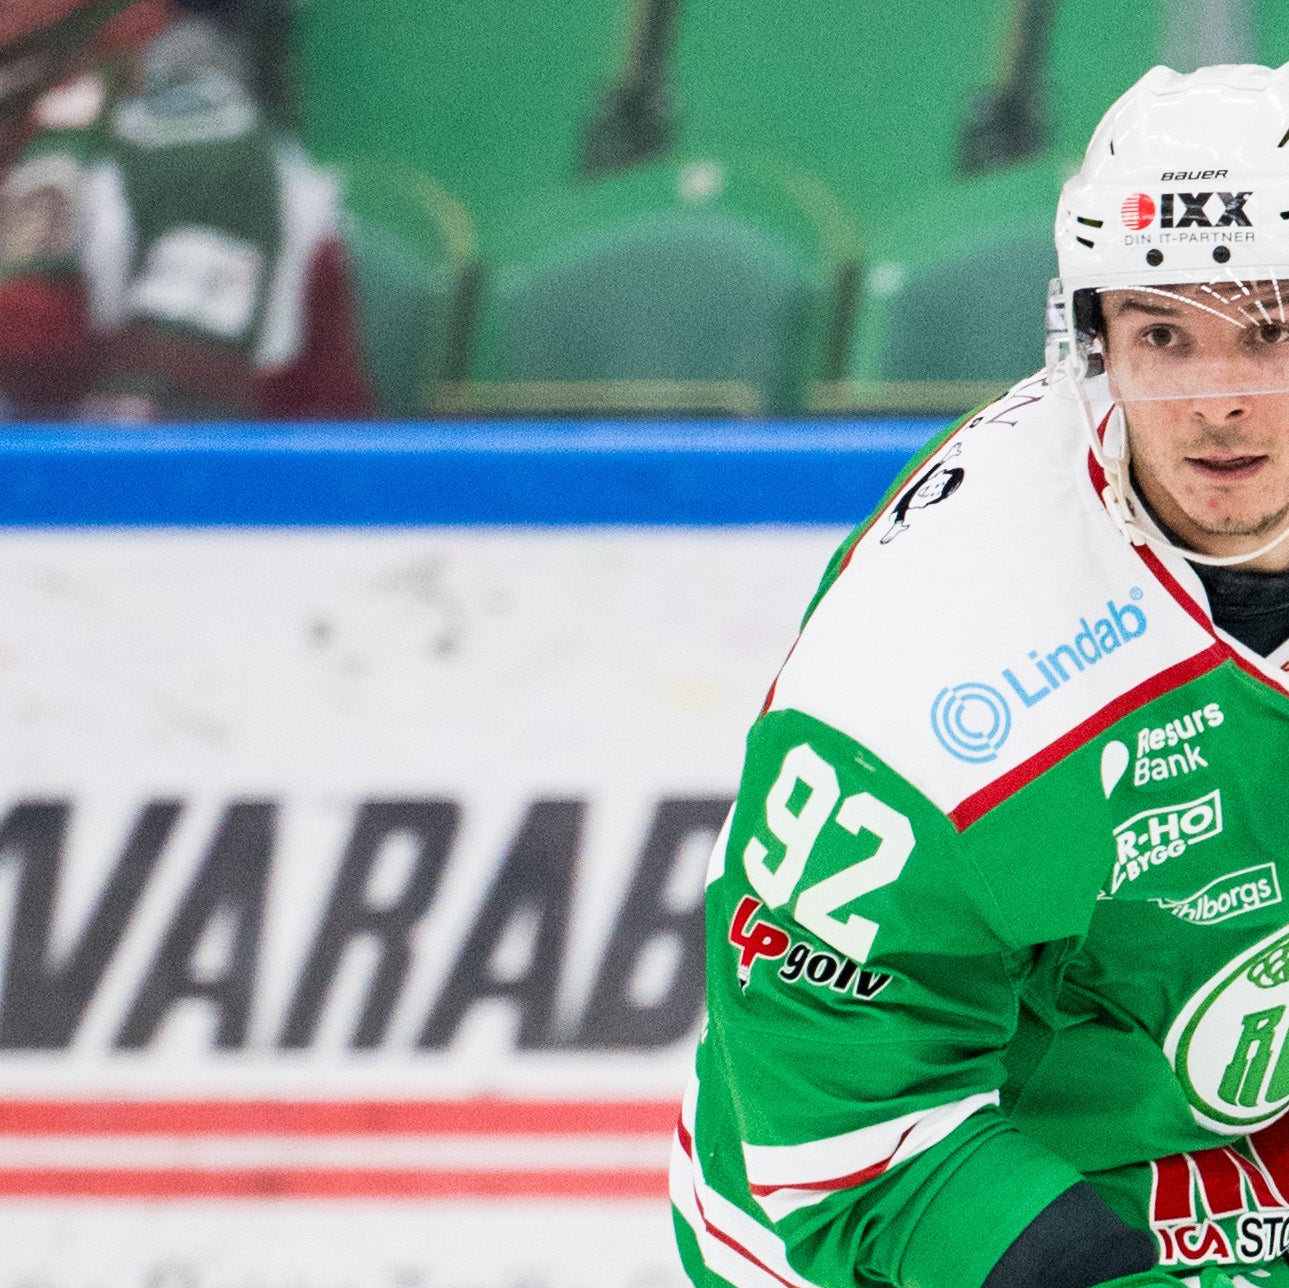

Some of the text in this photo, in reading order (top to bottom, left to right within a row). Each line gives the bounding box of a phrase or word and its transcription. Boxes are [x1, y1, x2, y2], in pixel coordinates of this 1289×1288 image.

[1160, 191, 1255, 229] IXX
[1124, 230, 1256, 246] DIN IT-PARTNER
[1136, 703, 1225, 759] Resurs
[1134, 742, 1209, 786] Bank
[742, 741, 916, 965] 92
[1116, 804, 1215, 865] R-HO
[1125, 839, 1187, 882] BYGG
[1156, 1219, 1231, 1263] ICA
